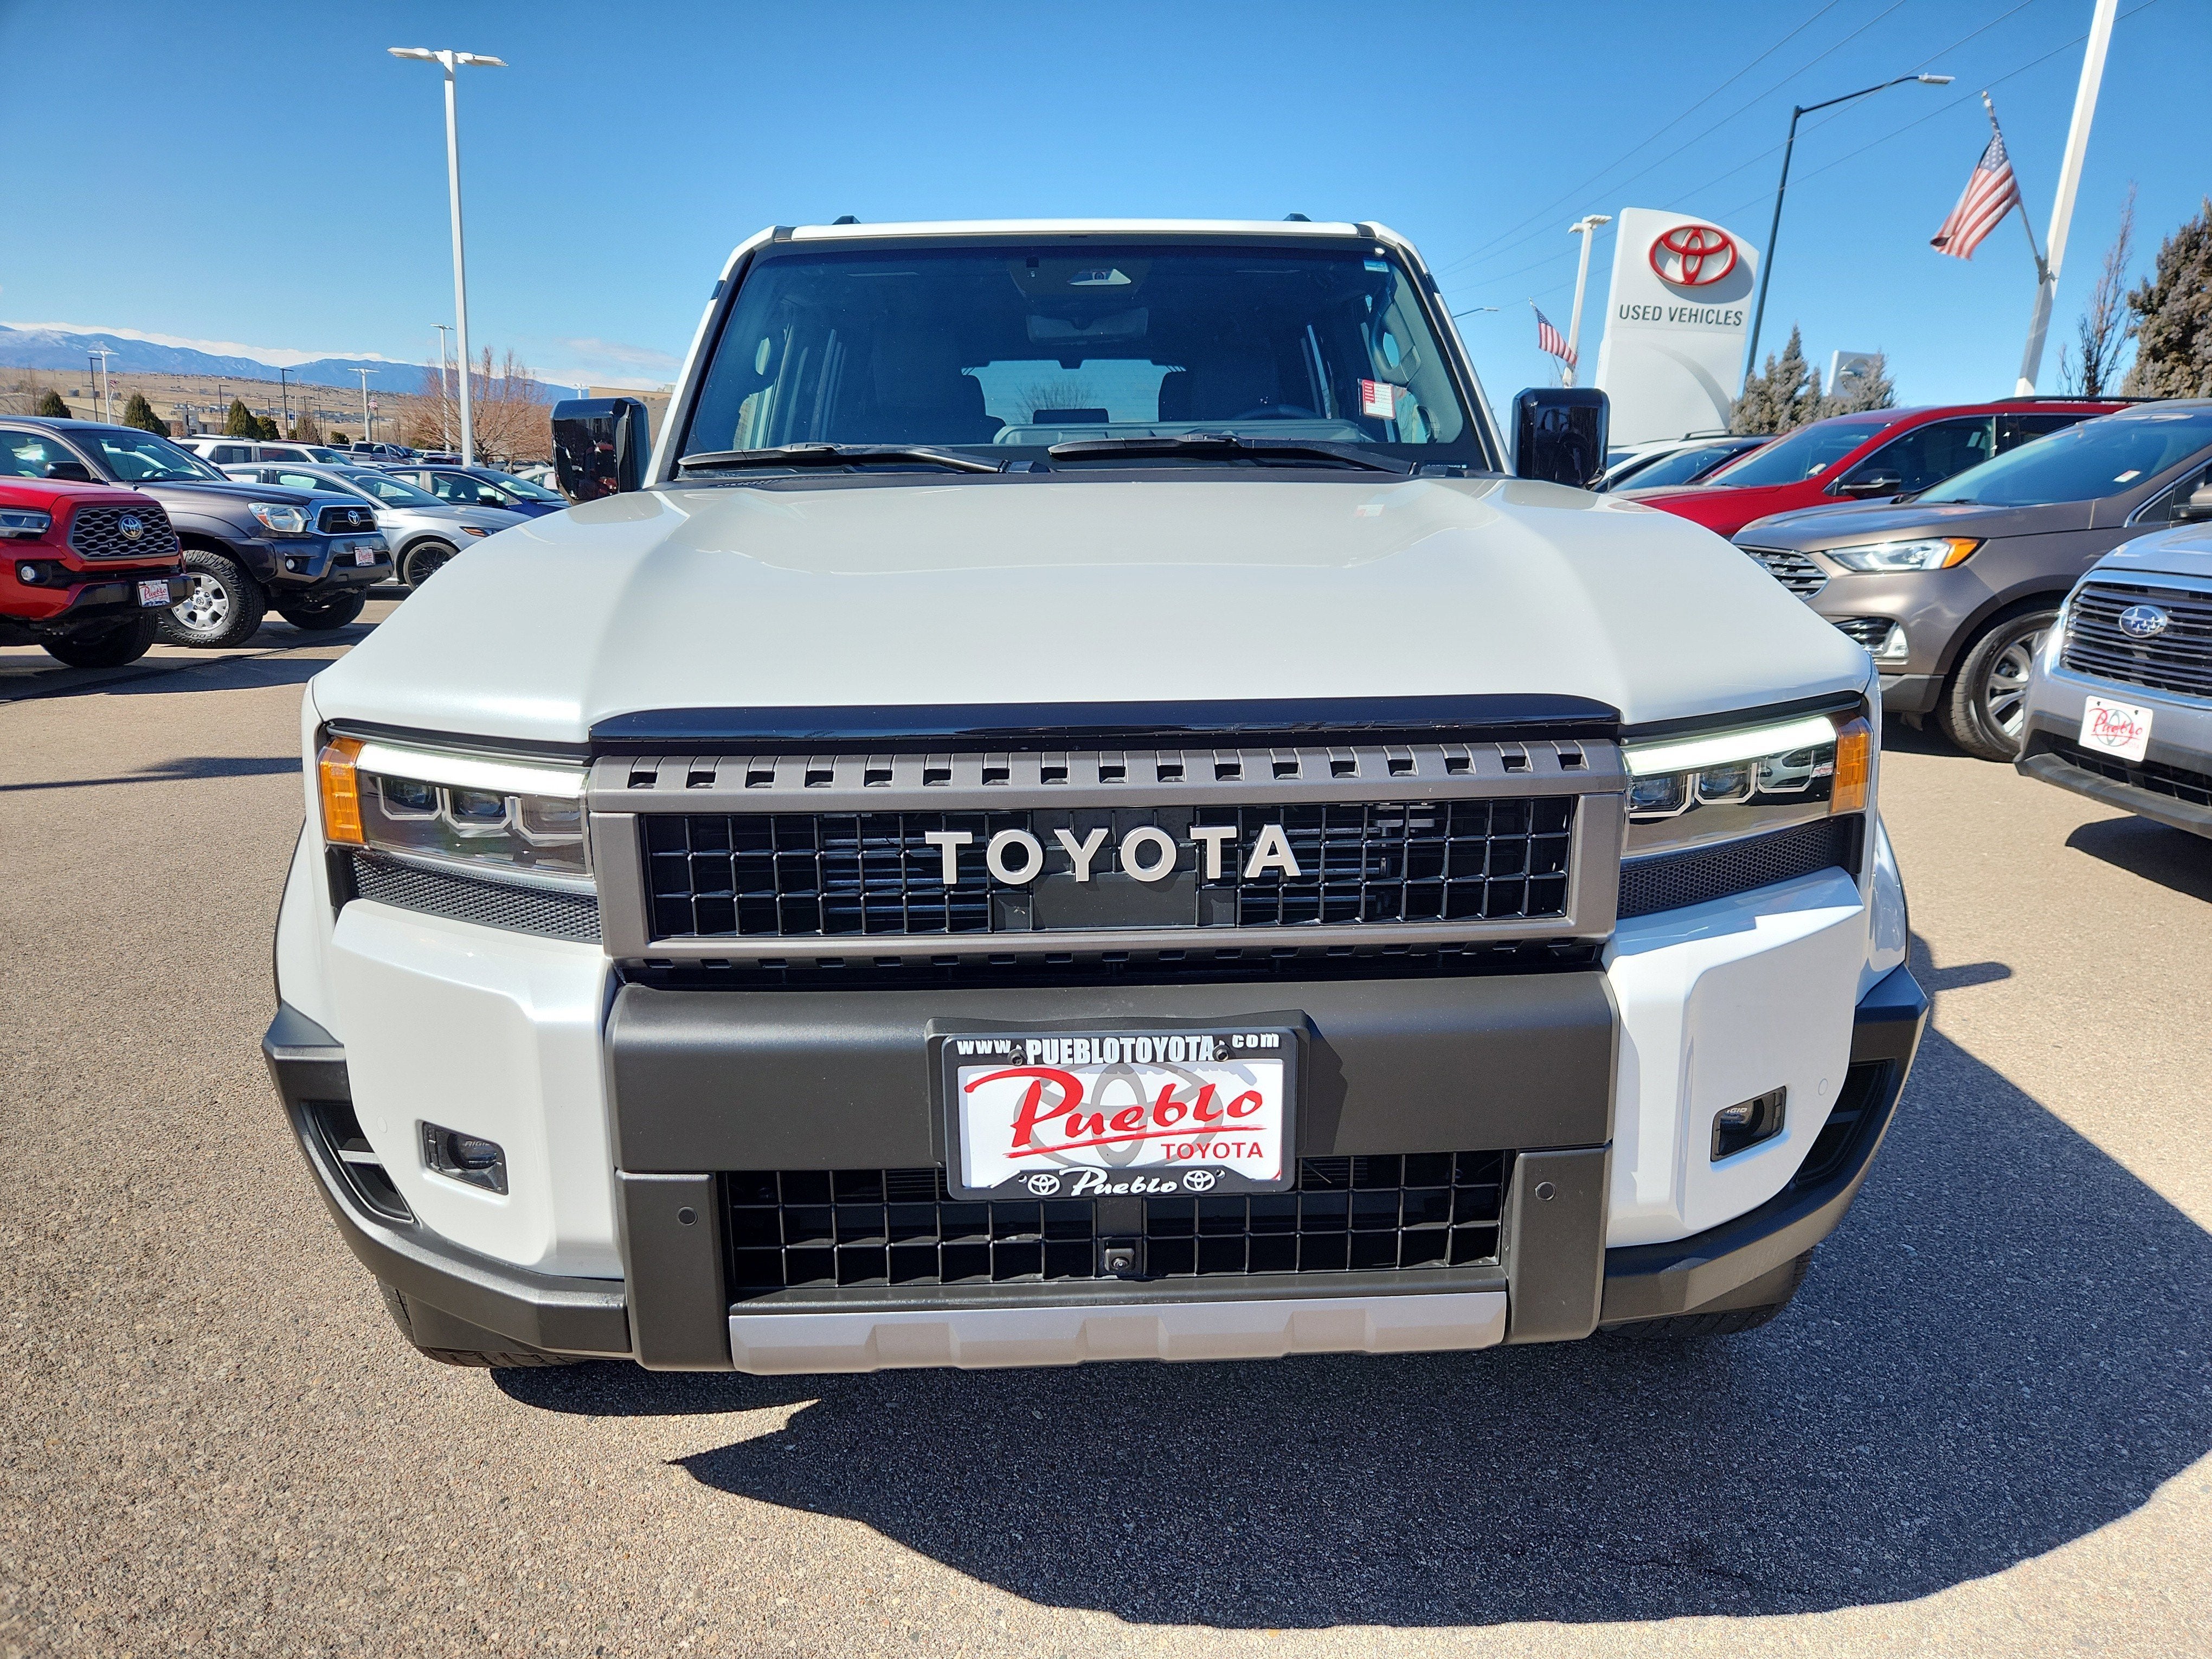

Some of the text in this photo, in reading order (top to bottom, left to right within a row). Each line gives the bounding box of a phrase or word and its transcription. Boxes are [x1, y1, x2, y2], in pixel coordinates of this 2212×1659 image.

[1619, 304, 1743, 326] USED VEHICLES
[2089, 708, 2143, 735] Pueblo
[924, 824, 1302, 885] TOYOTA
[964, 1066, 1263, 1148] Pueblo
[1161, 1142, 1263, 1160] TOYOTA
[1059, 1166, 1178, 1197] Pueblo
